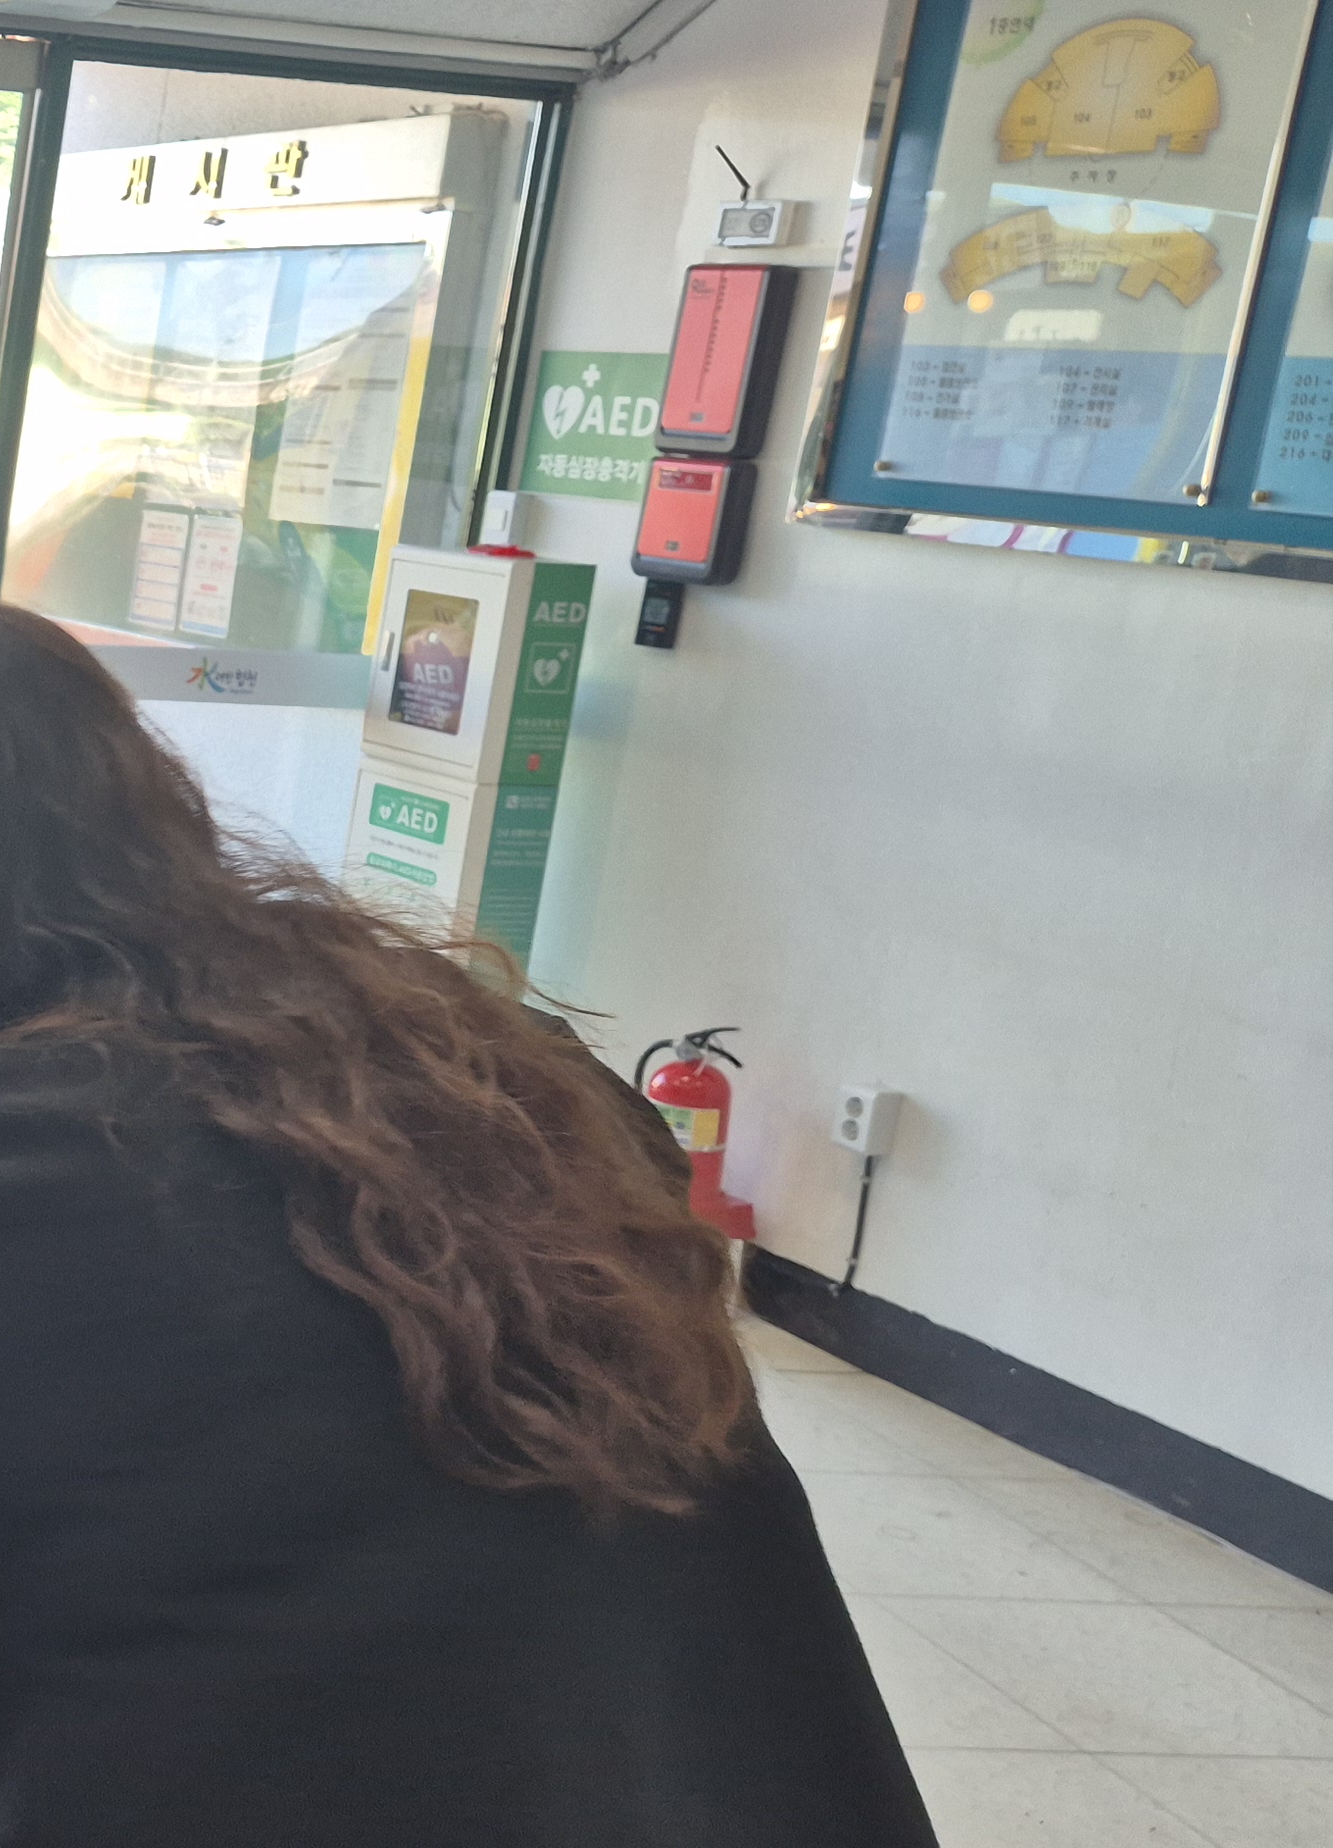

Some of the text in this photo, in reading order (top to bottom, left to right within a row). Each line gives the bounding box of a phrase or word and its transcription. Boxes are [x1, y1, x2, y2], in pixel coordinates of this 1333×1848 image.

[578, 394, 660, 437] AED
[536, 453, 645, 485] 자동심장충격기
[533, 600, 587, 624] AED
[412, 662, 454, 684] AED
[395, 804, 438, 833] AED
